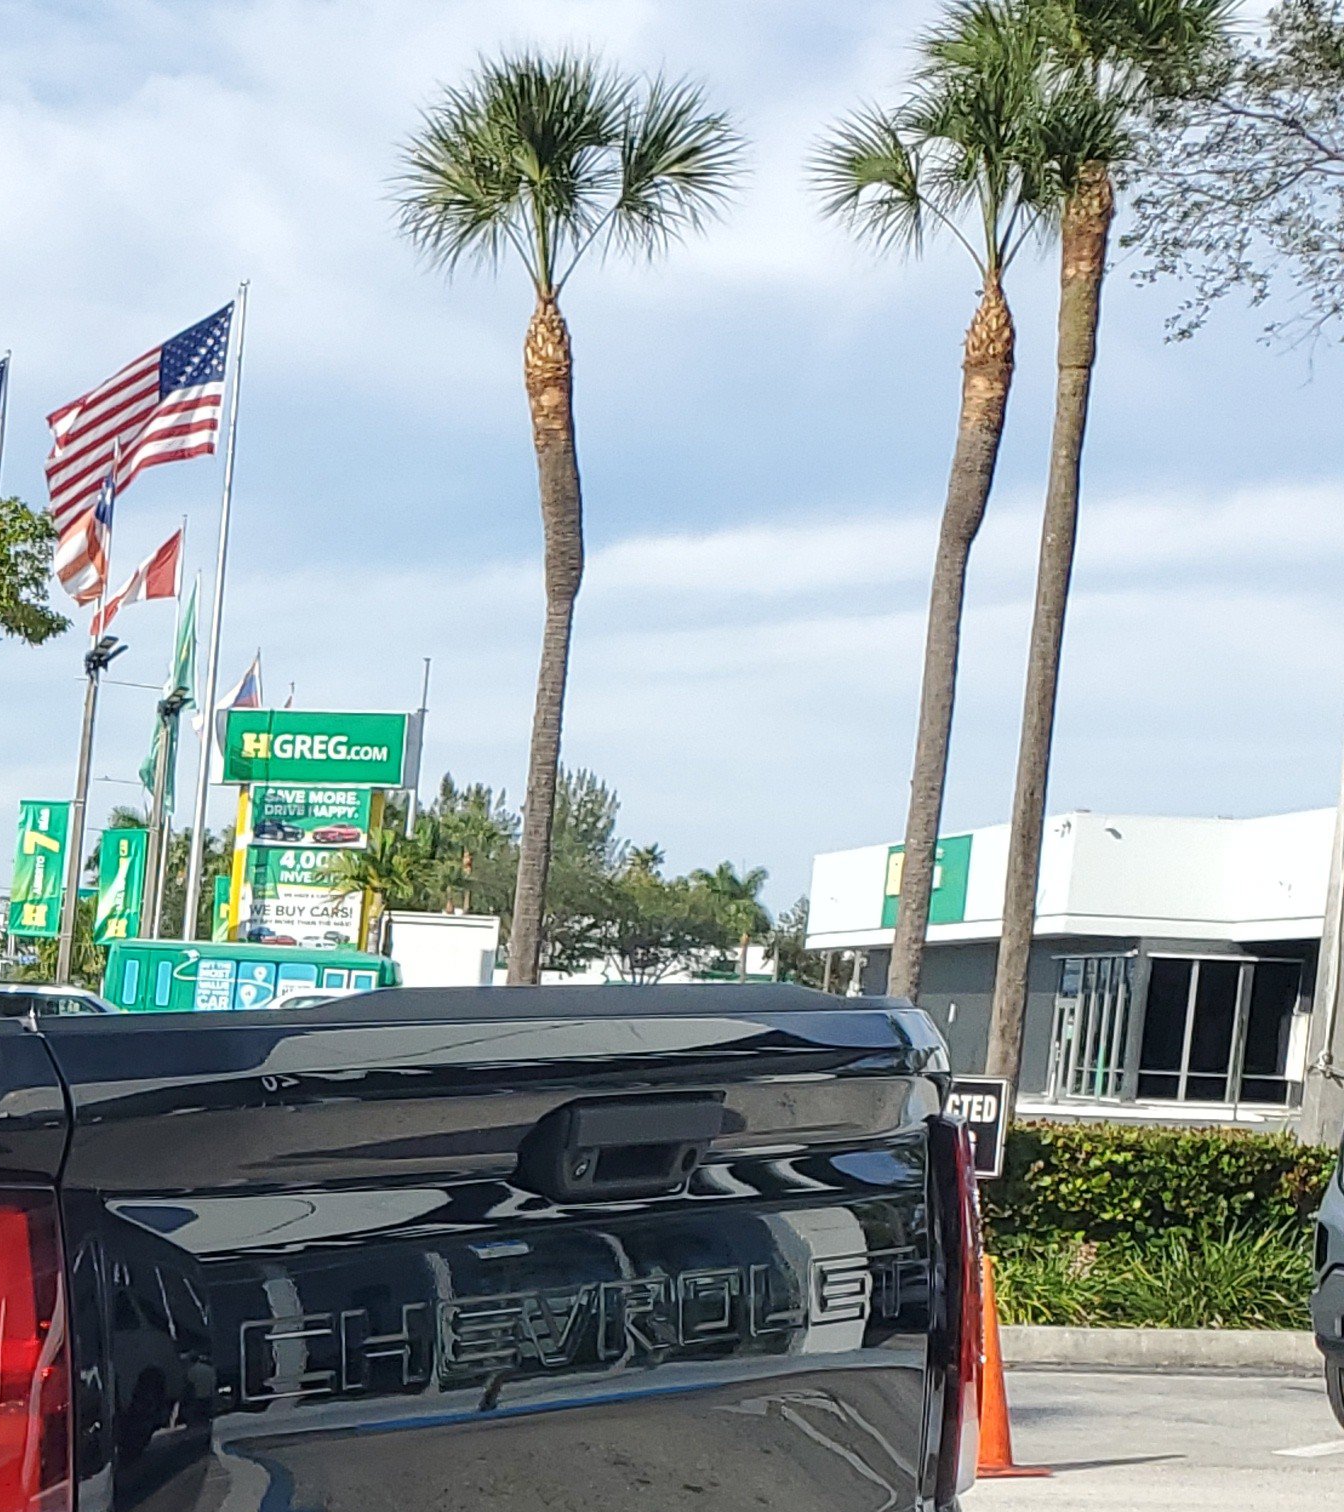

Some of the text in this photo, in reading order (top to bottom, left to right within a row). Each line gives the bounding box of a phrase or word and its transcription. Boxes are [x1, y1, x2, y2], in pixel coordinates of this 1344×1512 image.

[265, 788, 360, 805] SAVE MORE.
[265, 804, 305, 816] DRIVE
[23, 831, 60, 855] 7
[250, 904, 354, 919] WE BUY CARS!
[240, 1245, 932, 1400] CHEVROLET
